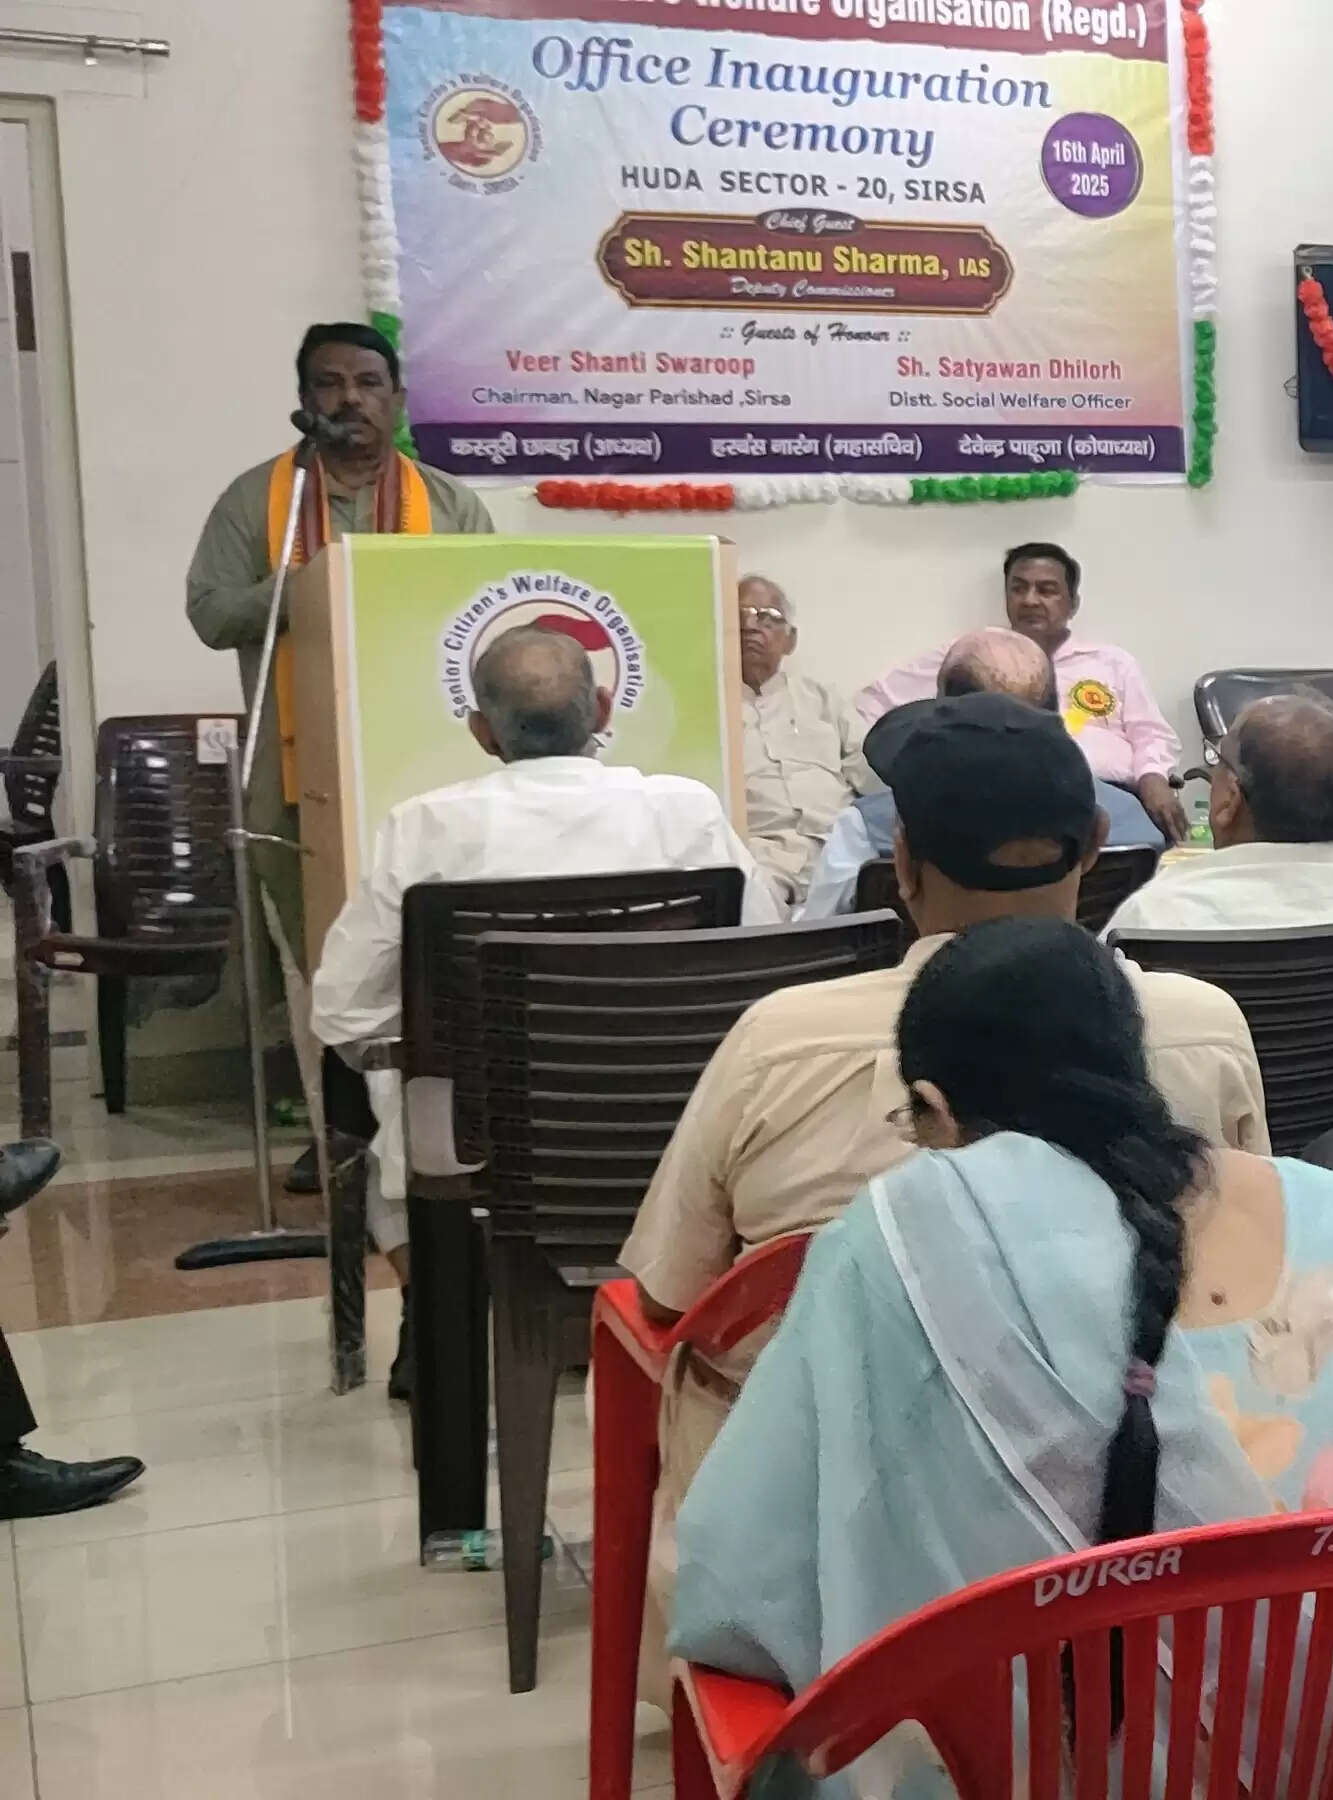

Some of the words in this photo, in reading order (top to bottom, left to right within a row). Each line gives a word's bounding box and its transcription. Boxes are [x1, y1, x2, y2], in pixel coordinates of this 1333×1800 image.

[1041, 0, 1147, 48] (Regd.)
[532, 35, 691, 92] Office
[704, 47, 1051, 108] Inauguration
[671, 104, 935, 168] Ceremony
[1053, 139, 1087, 163] 16th
[1091, 141, 1126, 169] April
[621, 165, 703, 192] HUDA
[720, 171, 829, 198] SECTOR
[856, 176, 895, 205] 20,
[904, 179, 986, 204] SIRSA
[1071, 173, 1110, 197] 2025
[624, 238, 672, 268] Sh.
[682, 240, 823, 273] Shantanu
[834, 246, 949, 280] Sharma,
[959, 258, 991, 279] IAS
[741, 320, 796, 345] Guests
[803, 324, 820, 346] of
[827, 322, 890, 343] Honour
[506, 350, 561, 372] Veer
[570, 350, 647, 374] Shanti
[655, 351, 756, 379] Swaroop
[897, 355, 930, 377] Sh.
[938, 357, 1041, 382] Satyawan
[1049, 358, 1122, 381] Dhilorh
[584, 387, 644, 409] Nagar
[650, 387, 733, 406] Parishad
[942, 391, 995, 408] Social
[999, 392, 1067, 409] Welfare
[1071, 393, 1133, 410] Officer
[511, 575, 592, 603] Welfare
[443, 586, 508, 652] Citizen's
[594, 595, 645, 709] Organisation
[441, 657, 474, 719] Senior
[1034, 1545, 1183, 1608] DURGA
